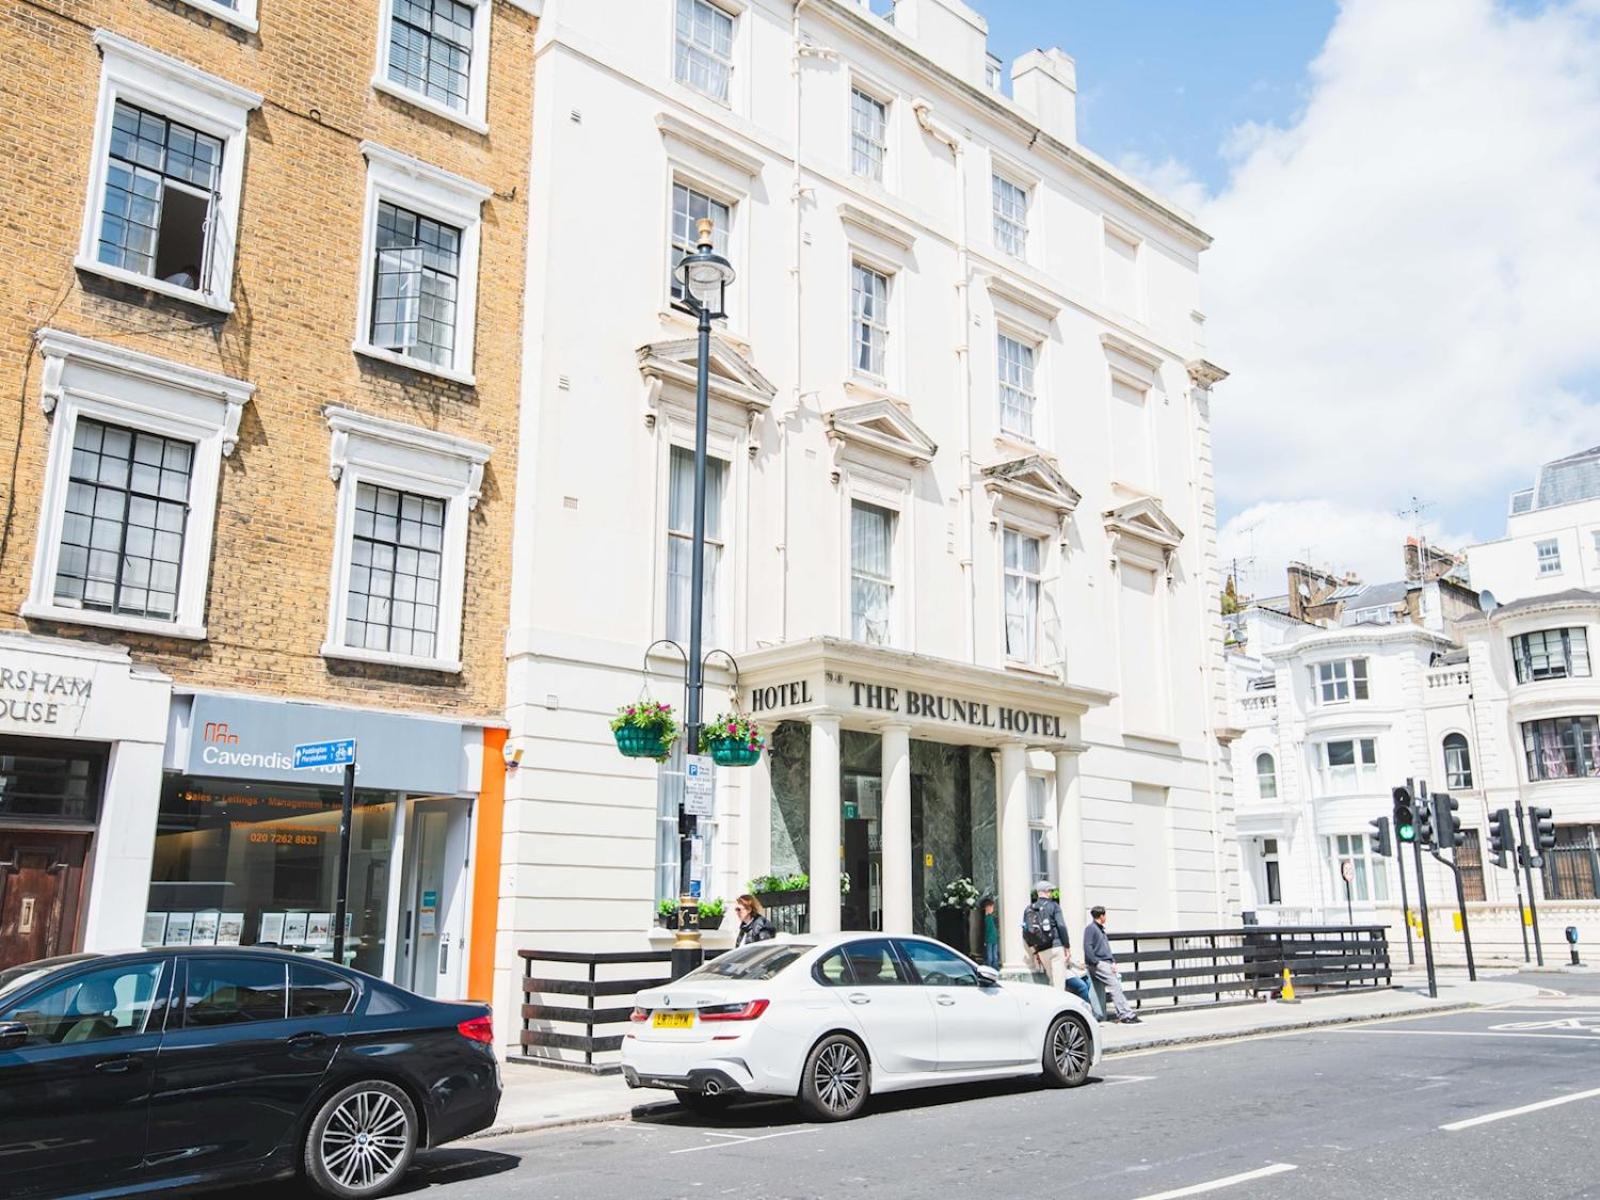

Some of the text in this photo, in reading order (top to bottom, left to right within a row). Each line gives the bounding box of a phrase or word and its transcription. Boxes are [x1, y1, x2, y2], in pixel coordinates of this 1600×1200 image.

[0, 667, 92, 698] RSHAM
[752, 680, 812, 712] HOTEL
[850, 681, 1066, 739] THE BRUNEL HOTEL
[203, 746, 292, 770] Cavendis
[250, 833, 268, 843] 020
